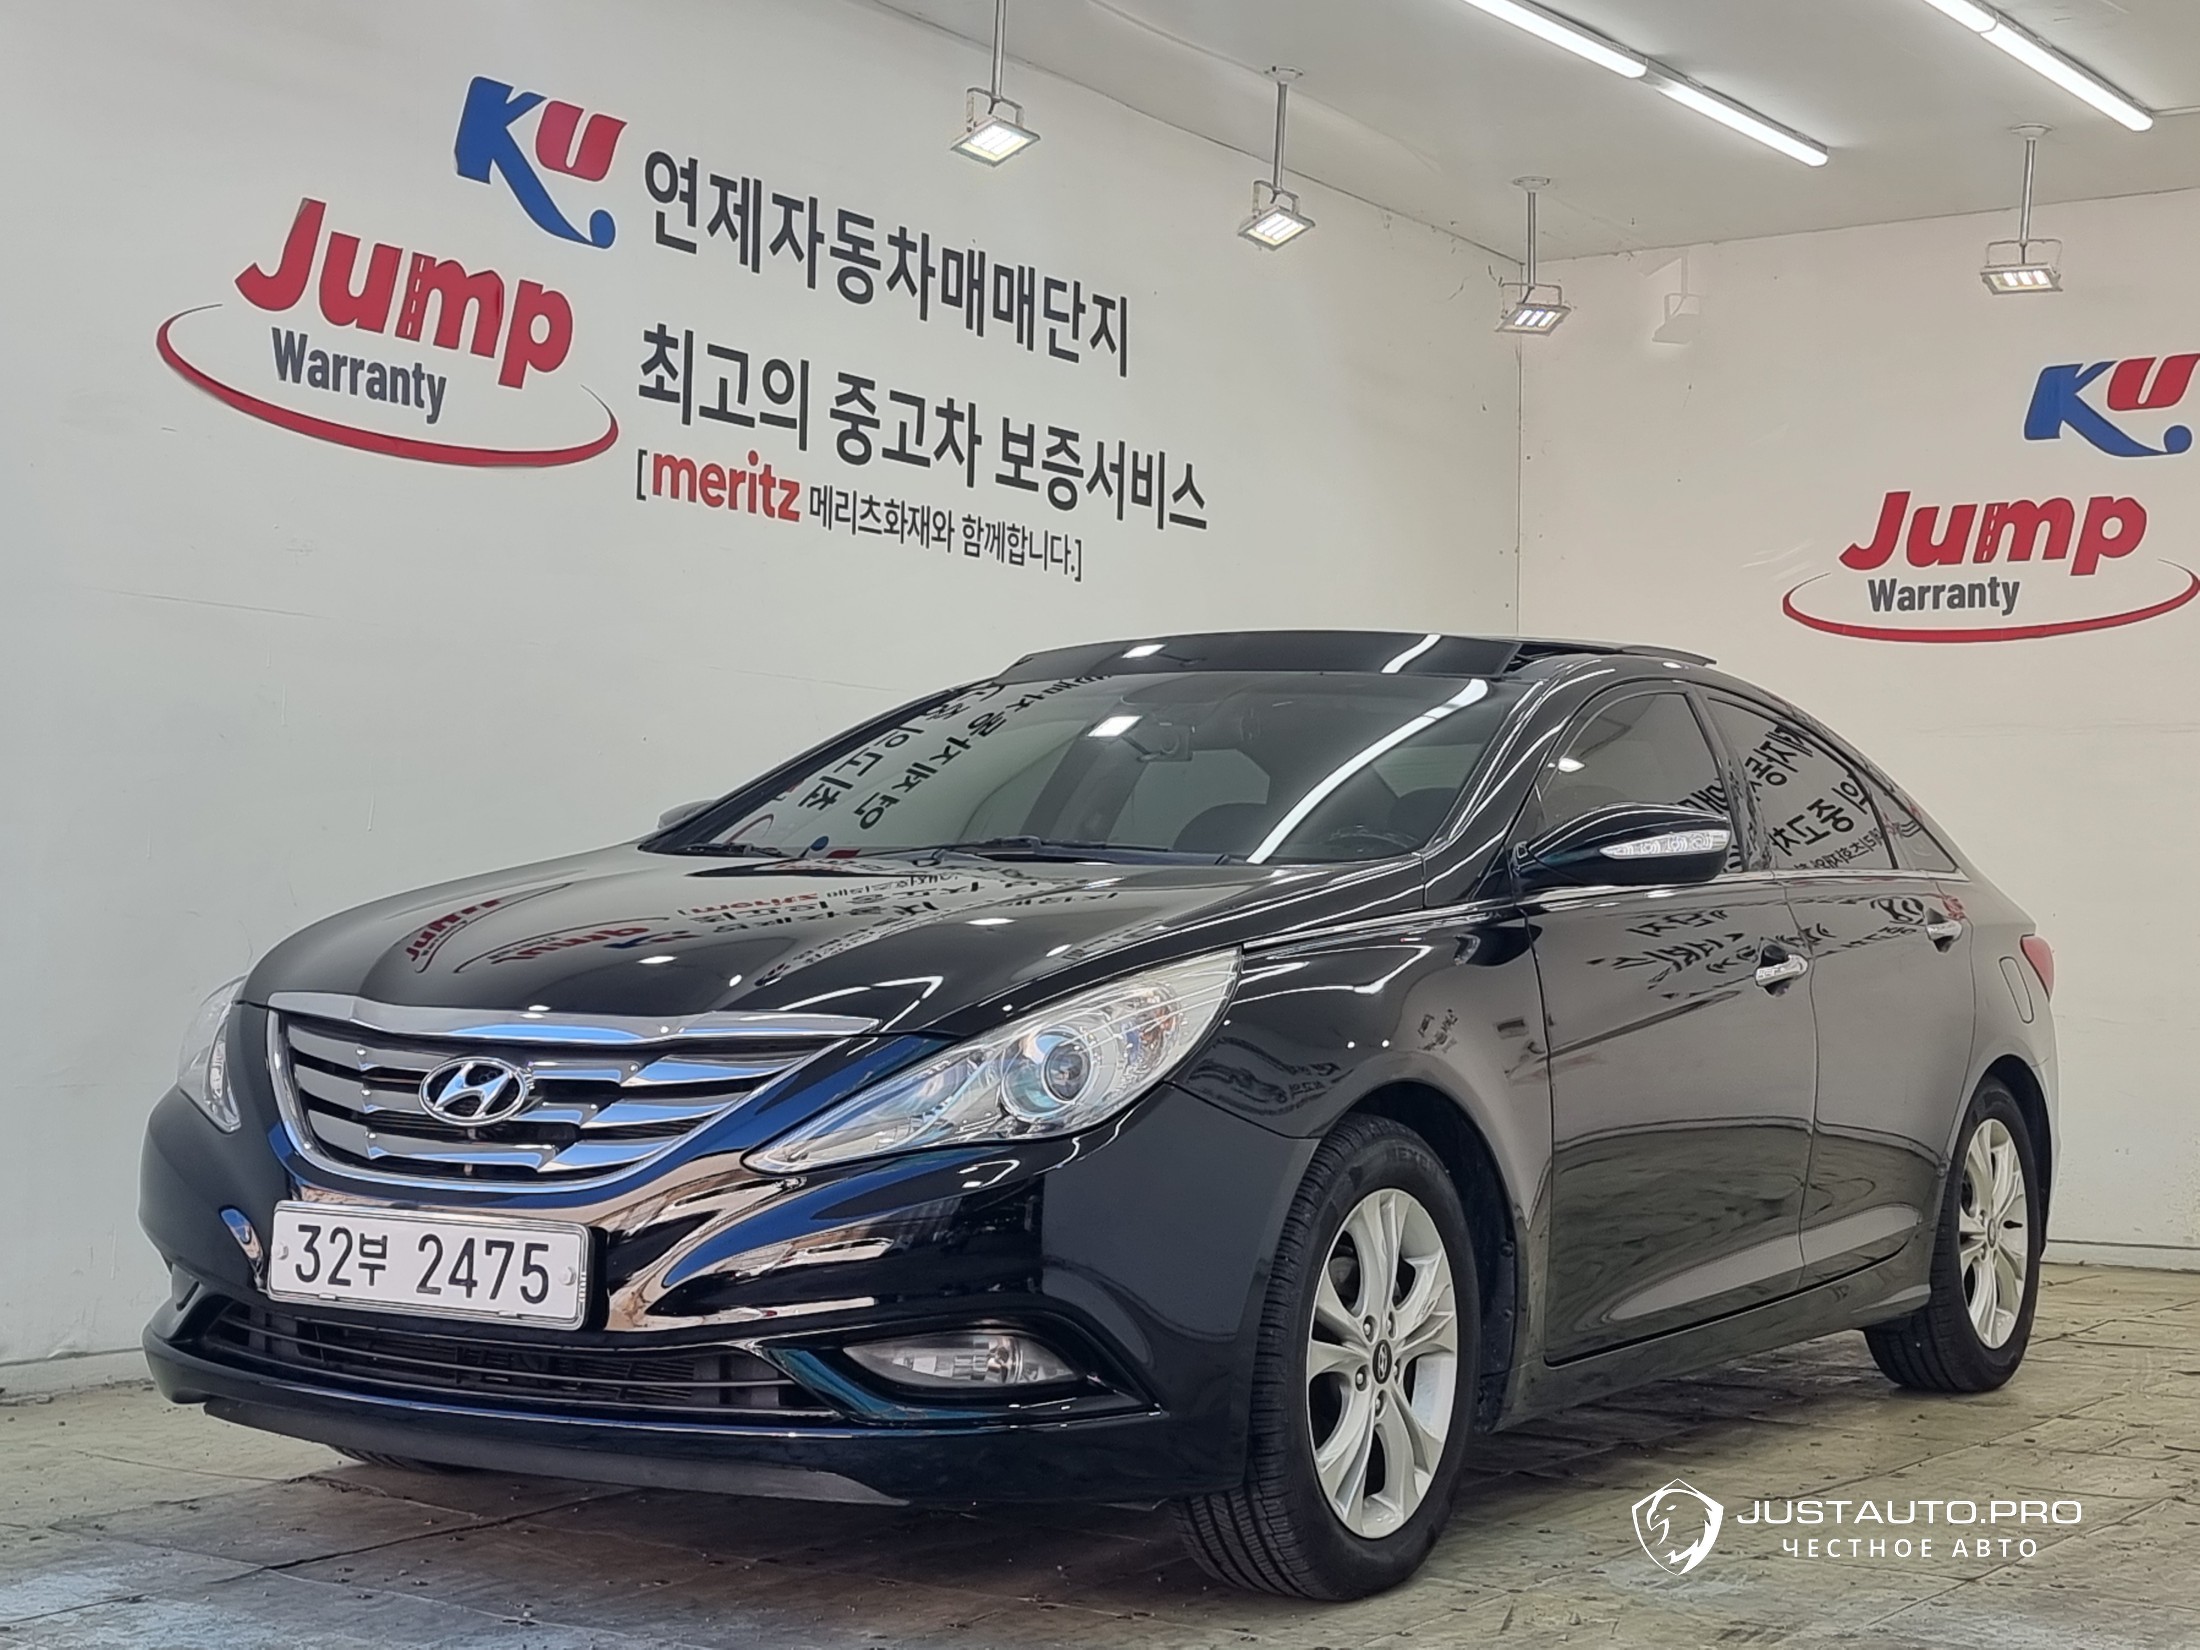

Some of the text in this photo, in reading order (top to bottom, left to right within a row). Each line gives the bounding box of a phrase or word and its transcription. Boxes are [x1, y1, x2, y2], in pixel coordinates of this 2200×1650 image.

[235, 198, 574, 390] Jump
[644, 150, 1128, 378] 연제자동차매매단지
[271, 326, 447, 424] Warranty
[638, 323, 1208, 530] 최고의 중고차 보증서비스
[809, 484, 955, 553] 메리츠화재와
[1838, 490, 2148, 576] Jump
[1868, 576, 2020, 616] Warranty
[295, 1224, 550, 1304] 32부 2475
